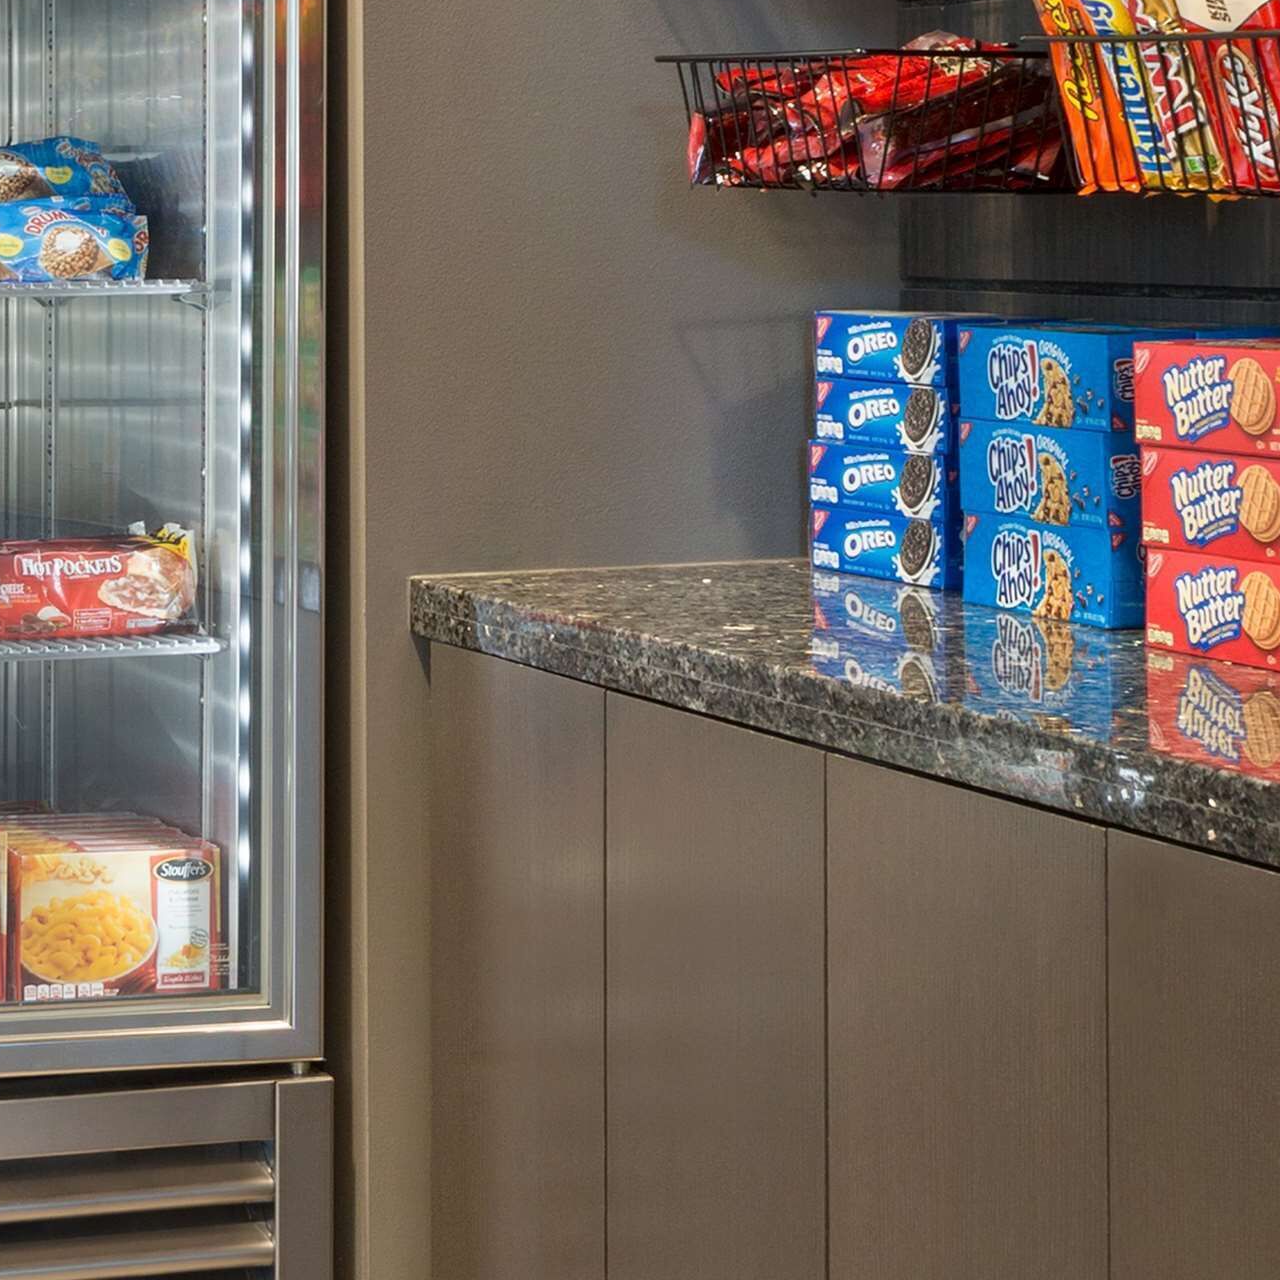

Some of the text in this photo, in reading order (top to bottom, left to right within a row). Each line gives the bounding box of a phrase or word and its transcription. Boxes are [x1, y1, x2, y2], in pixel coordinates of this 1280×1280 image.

[847, 331, 898, 362] OREO
[989, 344, 1029, 390] Chips
[1163, 357, 1225, 407] Nutter
[848, 398, 900, 429] OREO
[1173, 383, 1233, 436] Butter
[988, 438, 1027, 483] Chips
[1036, 434, 1070, 470] ORIGINAL
[842, 463, 896, 493] OREO
[1171, 463, 1235, 511] Nutter
[1180, 489, 1241, 541] Butter
[843, 529, 896, 558] OREO
[993, 535, 1031, 577] Chips
[1042, 531, 1076, 568] ORIGINAL
[21, 555, 122, 577] HOT POCKETS
[1176, 569, 1237, 613] Nutter
[1184, 595, 1245, 644] Butter
[160, 862, 206, 879] Stouffer's
